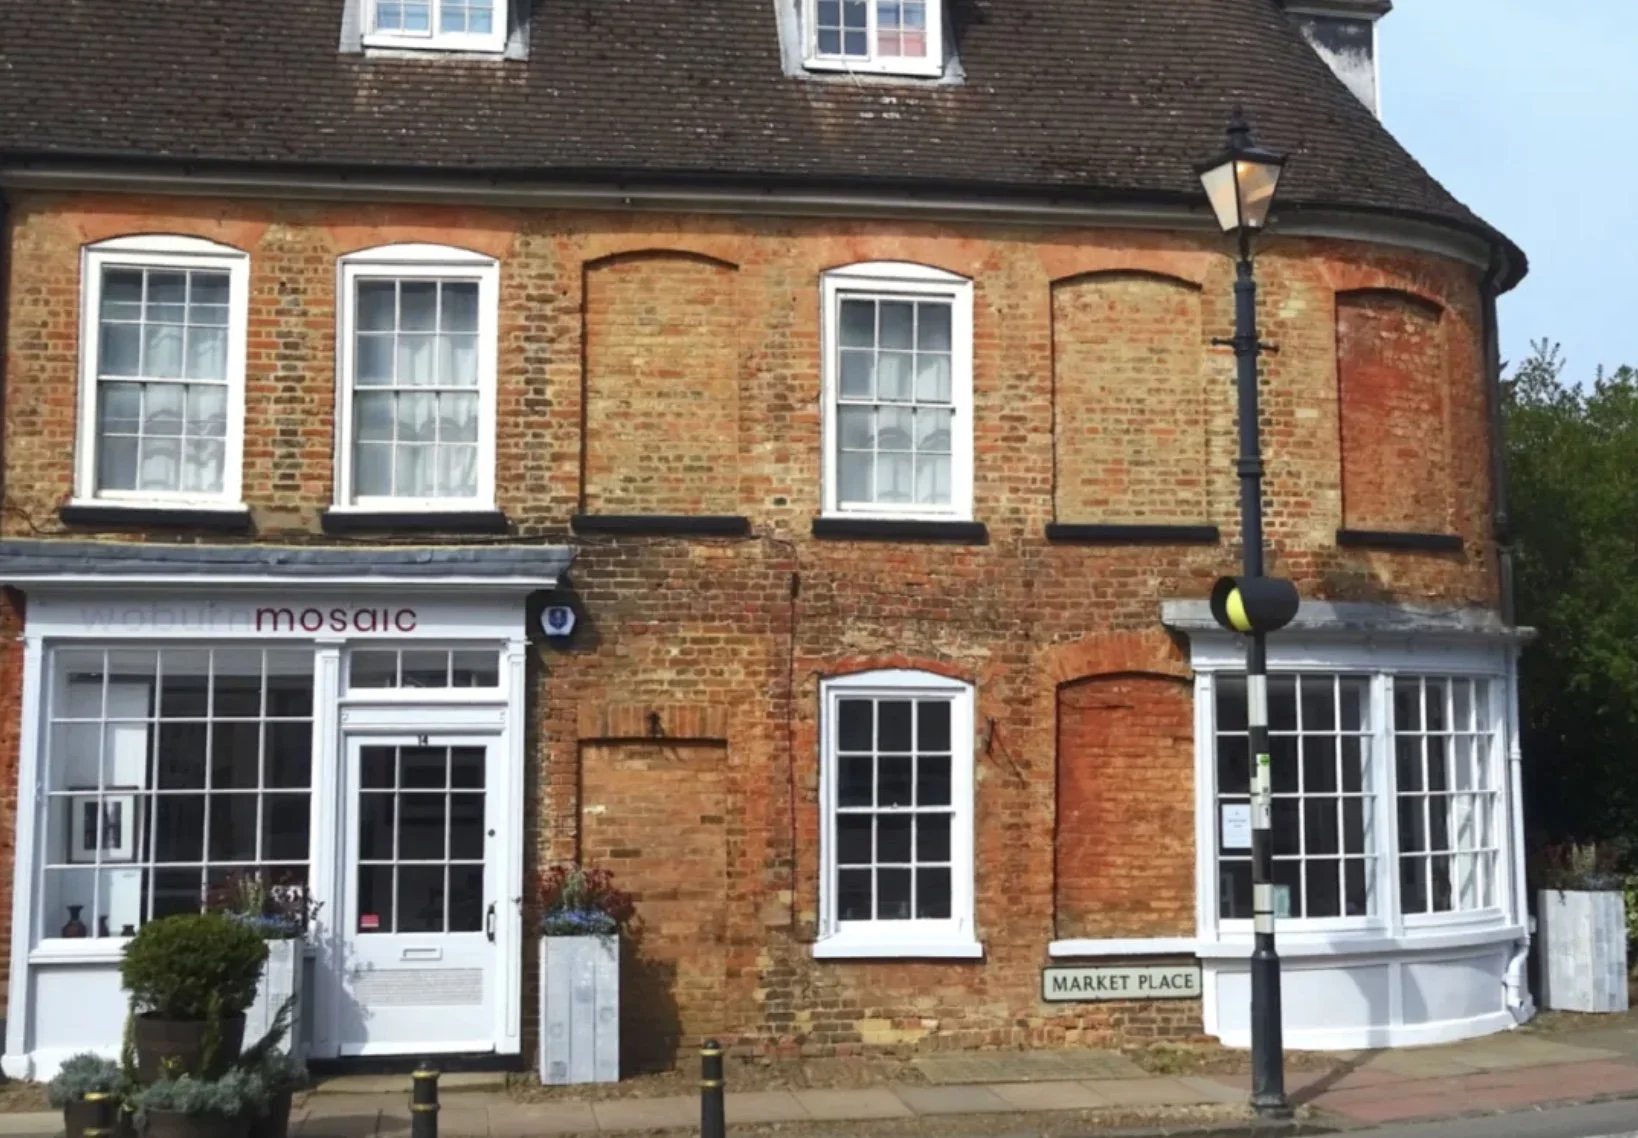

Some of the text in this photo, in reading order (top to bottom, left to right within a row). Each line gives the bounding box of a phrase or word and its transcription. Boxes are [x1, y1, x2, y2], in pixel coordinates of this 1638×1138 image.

[255, 607, 418, 633] mosaic
[1052, 973, 1195, 992] MARKET PLACE
